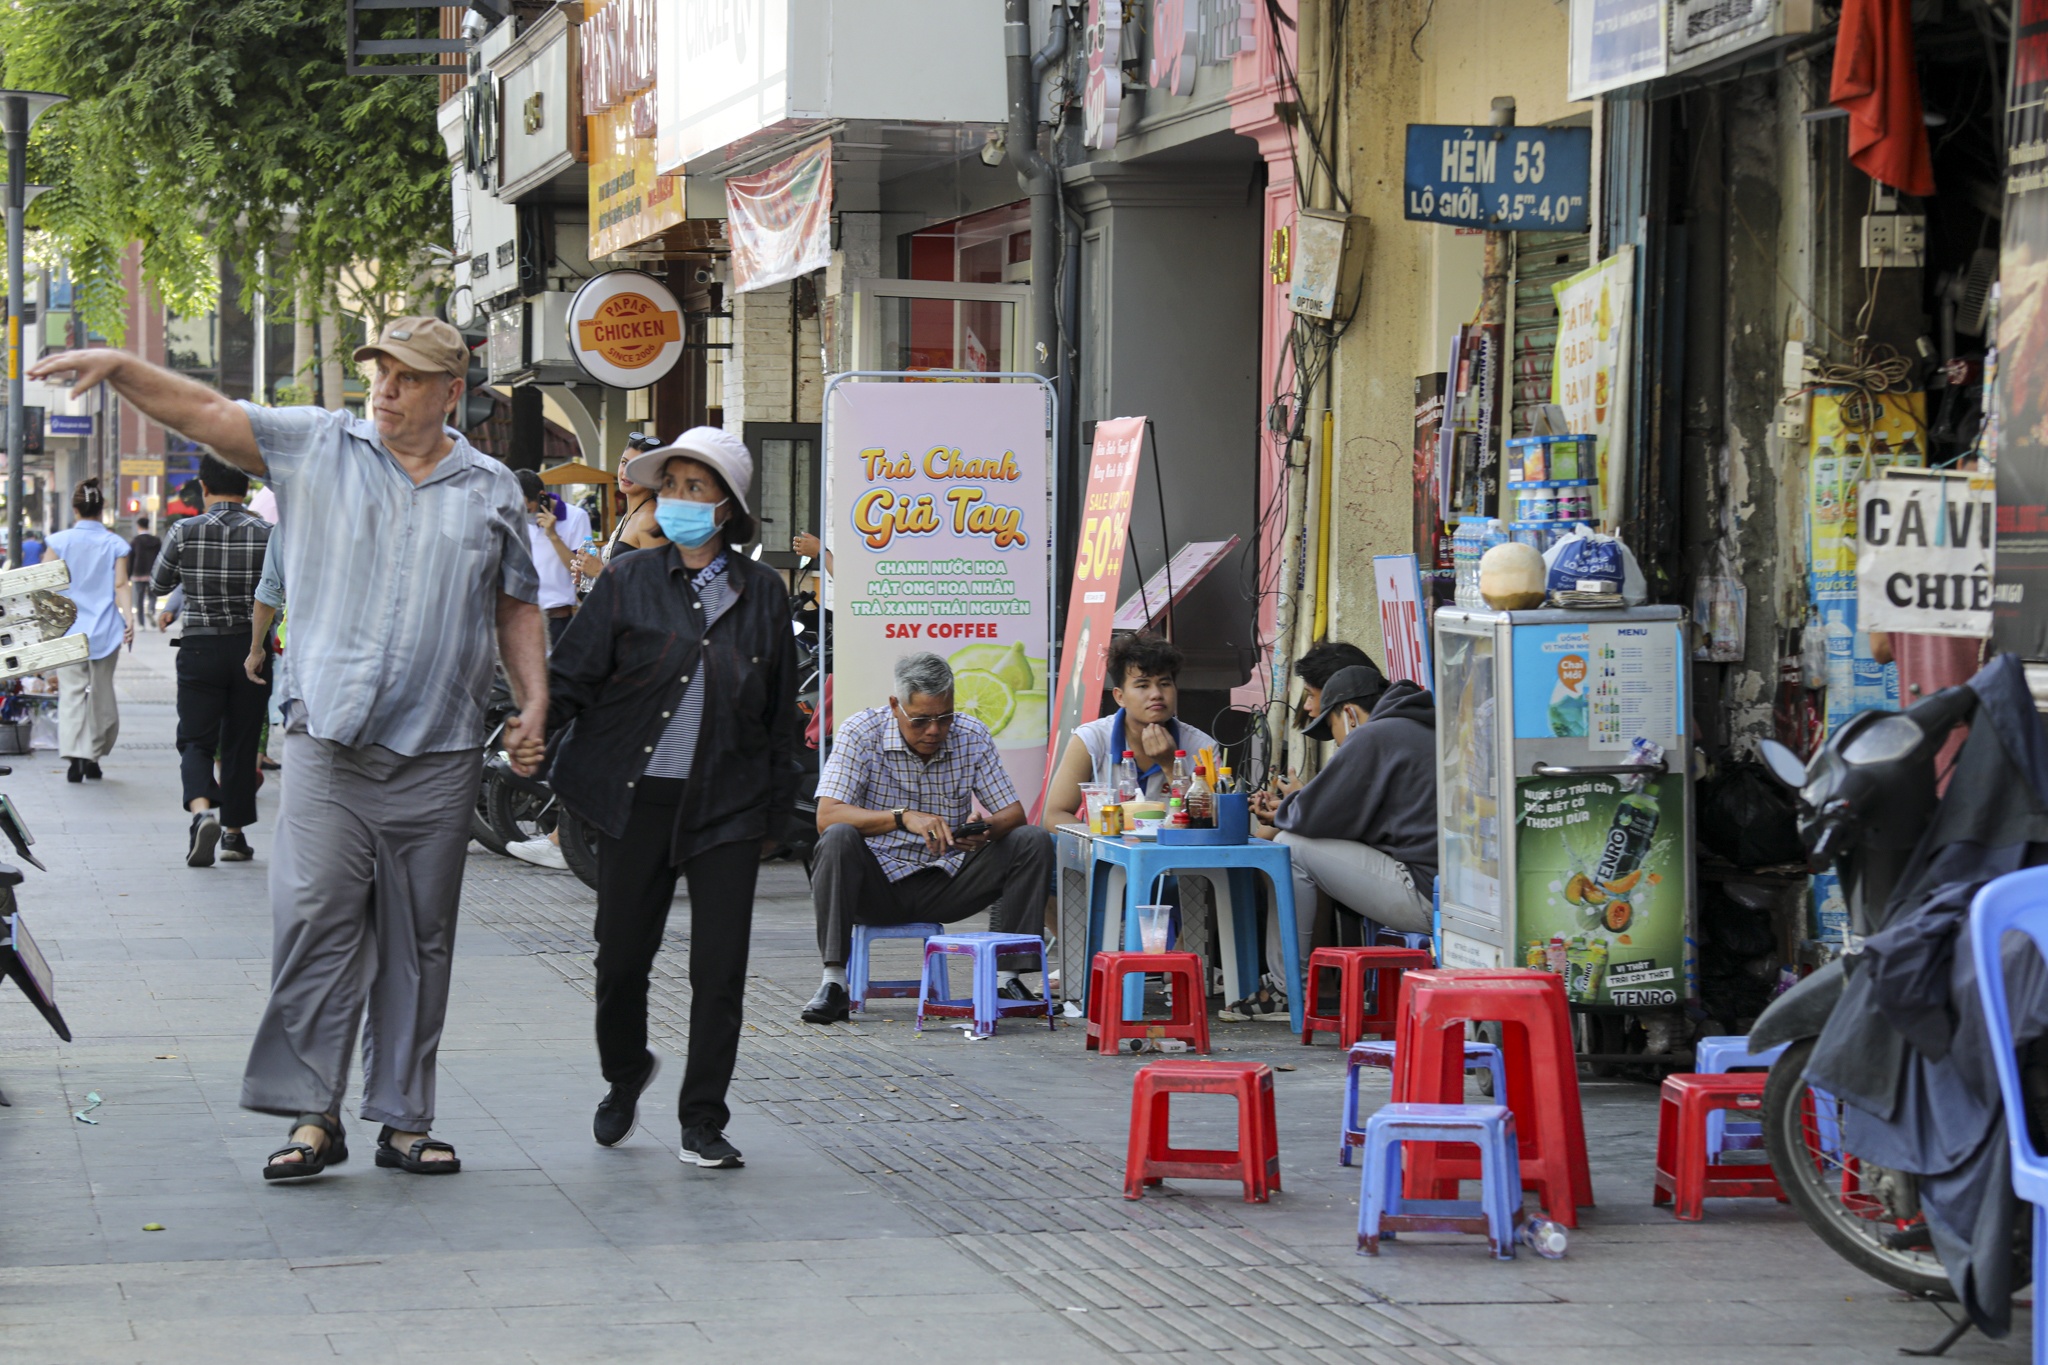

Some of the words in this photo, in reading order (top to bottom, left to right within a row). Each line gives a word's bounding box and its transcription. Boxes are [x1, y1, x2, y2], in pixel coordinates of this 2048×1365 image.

[1441, 128, 1497, 183] HẺM
[1513, 140, 1545, 184] 53
[1411, 185, 1434, 217] LỘ
[1297, 296, 1323, 312] OPTONE
[594, 320, 665, 342] CHICKEN
[608, 347, 634, 363] SINCE
[636, 344, 655, 361] 2006
[860, 448, 916, 482] Trà
[922, 446, 1021, 482] Chanh
[1089, 493, 1109, 511] SALE
[946, 488, 1026, 548] Tay
[1864, 489, 1927, 547] CÁ
[875, 560, 929, 576] CHANH
[931, 558, 973, 576] NƯỚC
[974, 561, 1008, 575] HOA
[868, 578, 900, 598] MẬT
[902, 581, 936, 595] ONG
[937, 581, 969, 595] HOA
[851, 598, 882, 615] TRÀ
[884, 601, 929, 615] XANH
[931, 598, 967, 615] THÁI
[969, 598, 1030, 615] NGUYÊN
[885, 623, 922, 639] SAY
[926, 623, 998, 639] COFFEE
[1561, 660, 1584, 670] Chai
[1563, 670, 1582, 680] Mới
[1554, 787, 1567, 798] ÉP
[1568, 781, 1592, 795] TRÁI
[1594, 783, 1614, 795] CÂY
[1525, 816, 1563, 830] THẠCH
[1594, 830, 1626, 886] TENRO
[1612, 990, 1676, 1006] TENRO
